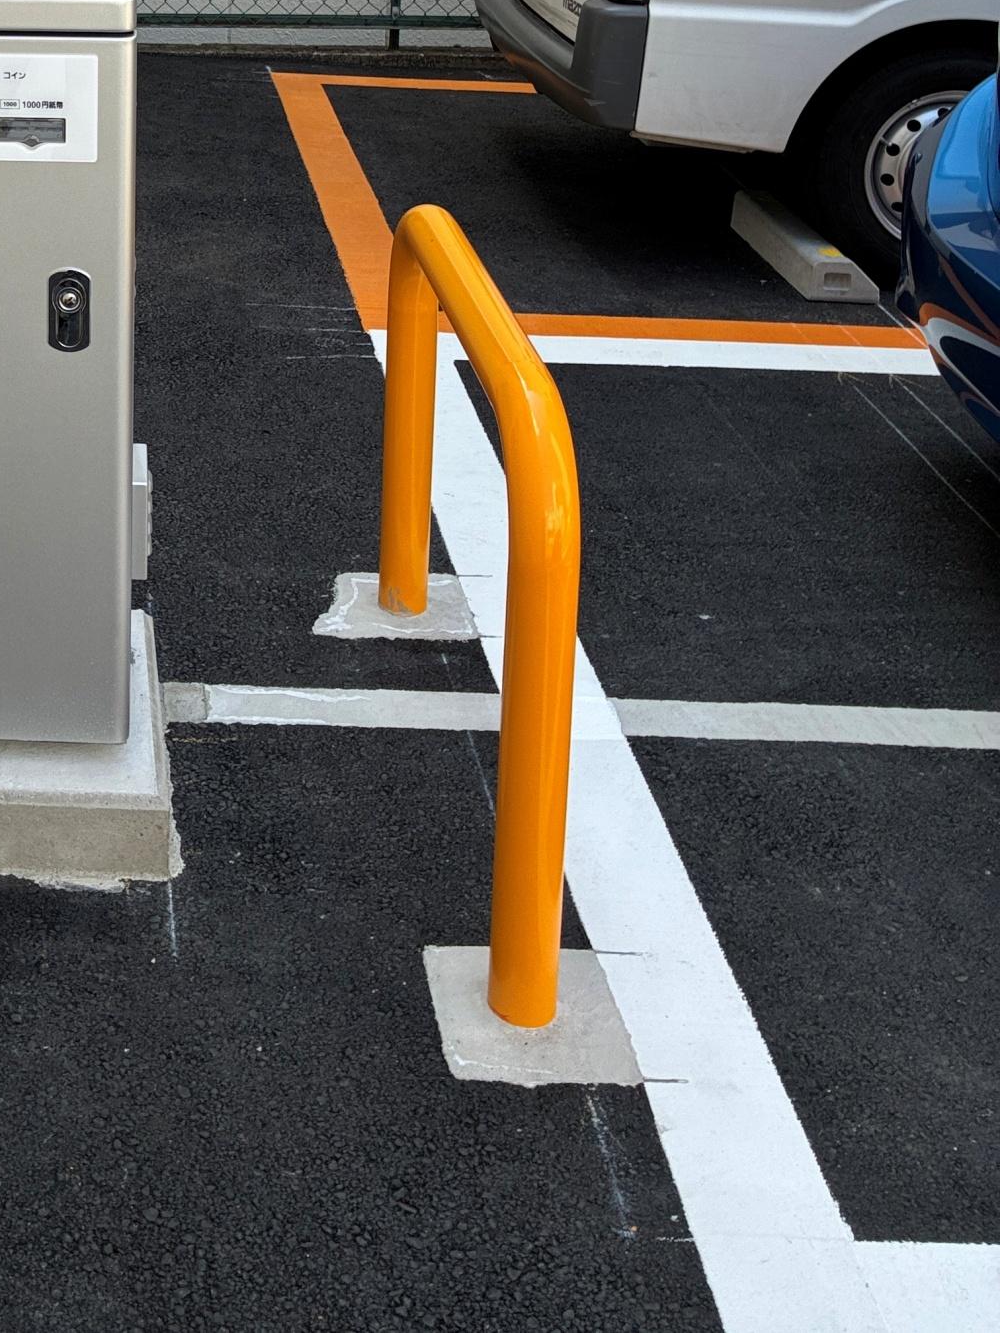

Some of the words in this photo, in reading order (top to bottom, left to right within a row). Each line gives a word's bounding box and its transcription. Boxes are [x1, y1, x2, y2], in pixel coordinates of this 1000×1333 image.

[3, 71, 27, 80] コイン
[22, 101, 64, 109] 1000円紙幣
